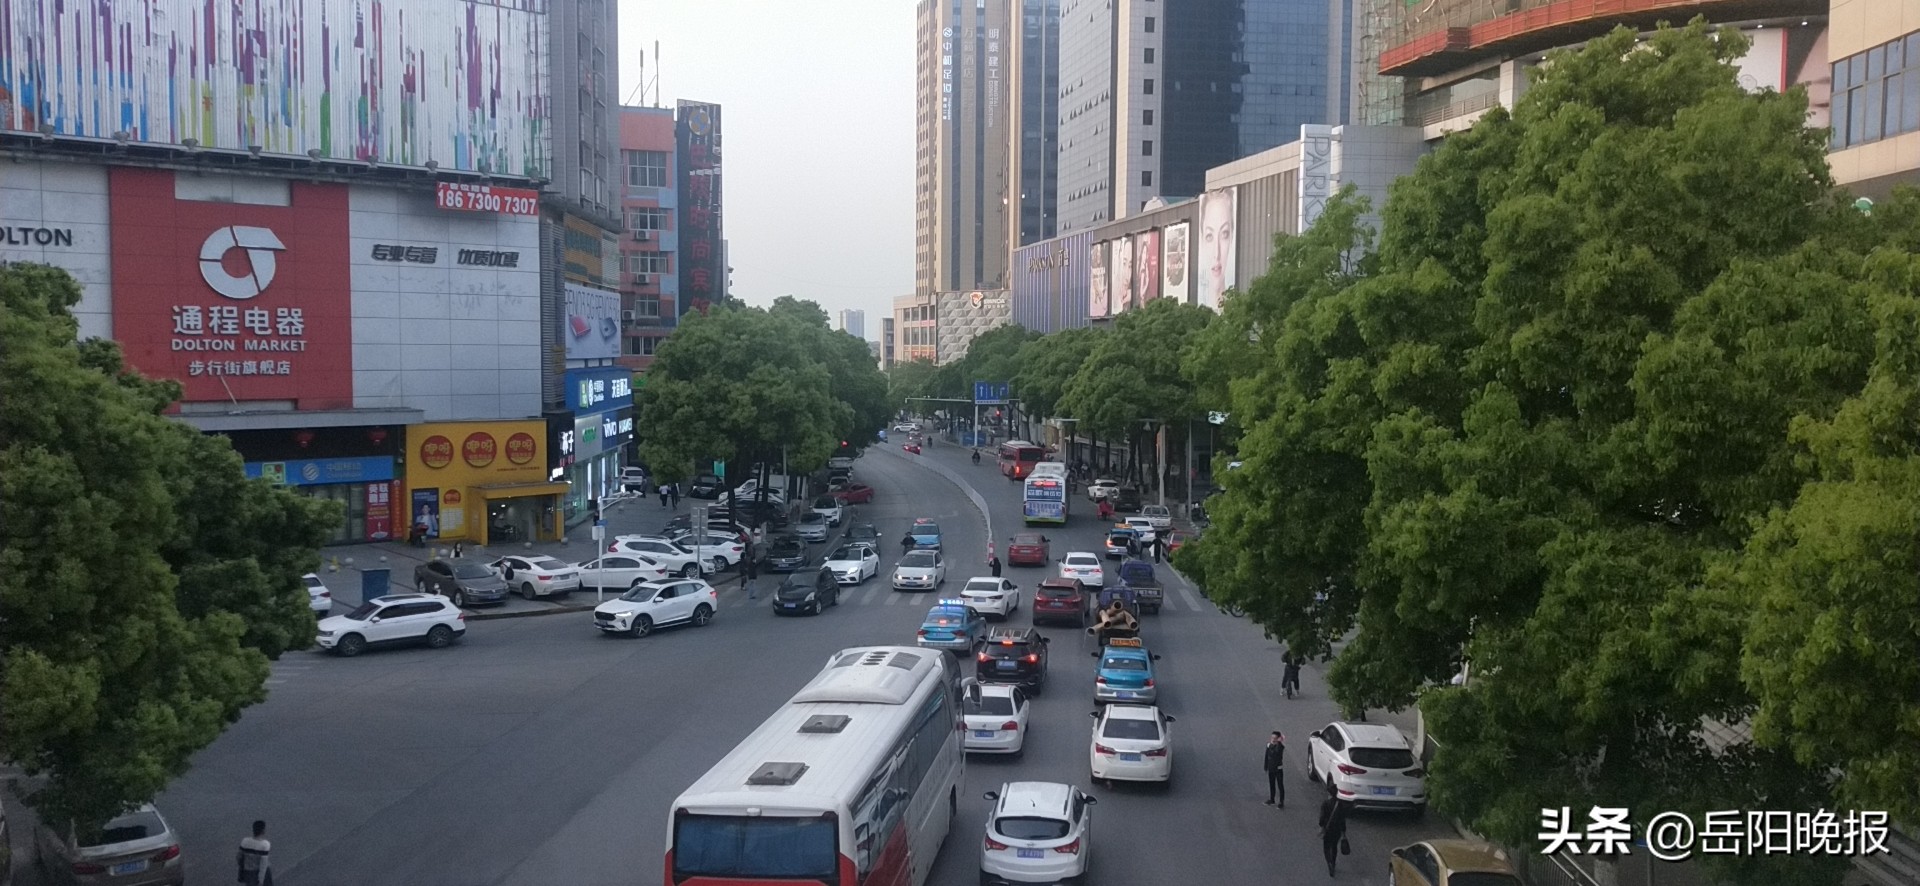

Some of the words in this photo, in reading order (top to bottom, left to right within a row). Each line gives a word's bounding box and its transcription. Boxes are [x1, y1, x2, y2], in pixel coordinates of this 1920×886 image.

[438, 189, 463, 208] 186
[467, 192, 501, 212] 7300
[504, 196, 537, 215] 7307
[0, 226, 72, 246] LTON
[371, 243, 438, 265] 专业专营
[457, 248, 520, 268] 优质优惠
[172, 305, 304, 335] 通程电器
[171, 339, 235, 351] DOLTON
[244, 340, 307, 351] MARKET
[189, 360, 291, 376] 步行街旗舰店
